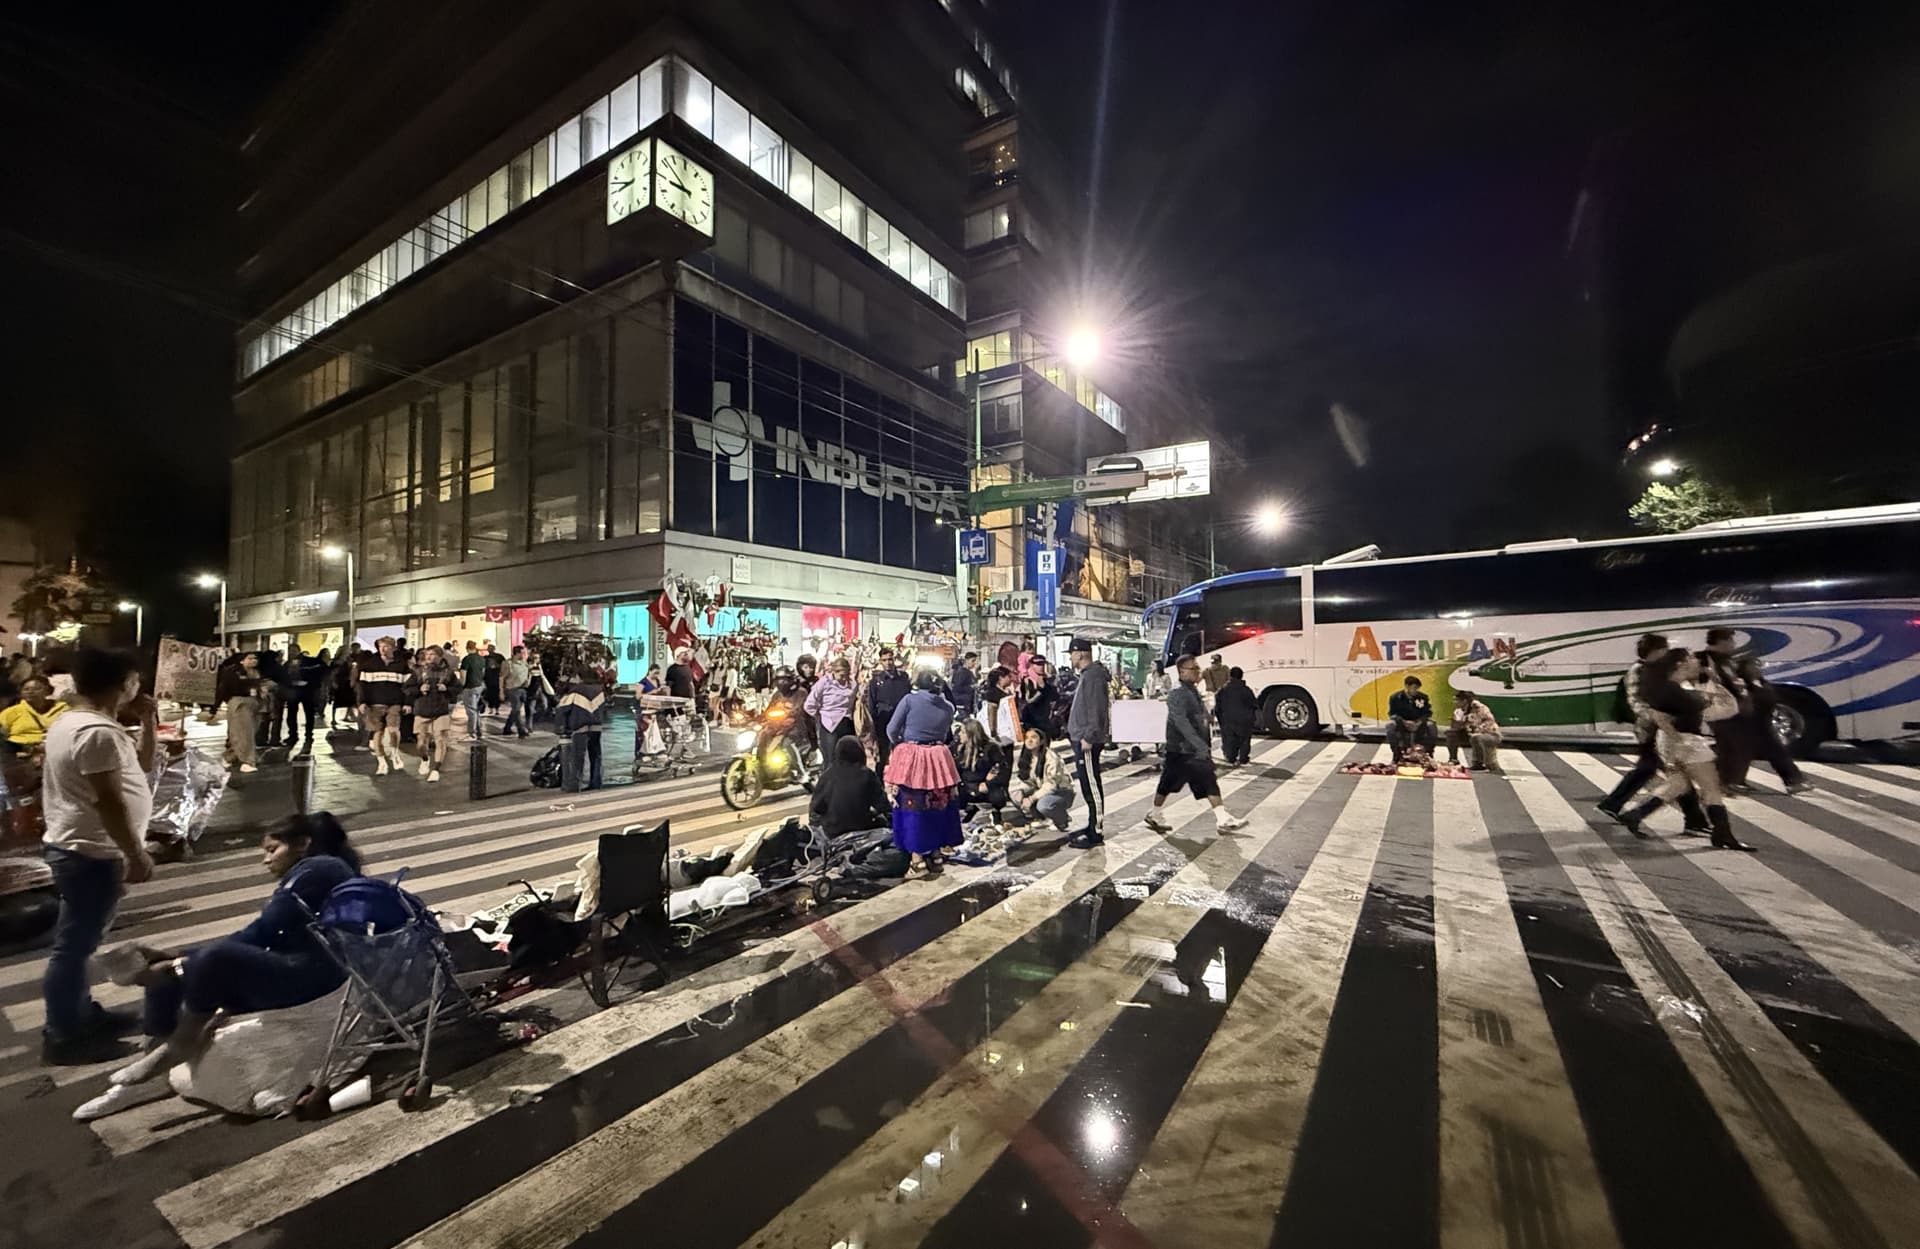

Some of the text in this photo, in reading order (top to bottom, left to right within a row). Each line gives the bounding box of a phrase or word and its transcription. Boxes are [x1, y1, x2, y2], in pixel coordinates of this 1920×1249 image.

[775, 425, 961, 520] INBURSA
[657, 625, 665, 660] INISO
[1347, 626, 1516, 661] ATEMPAN
